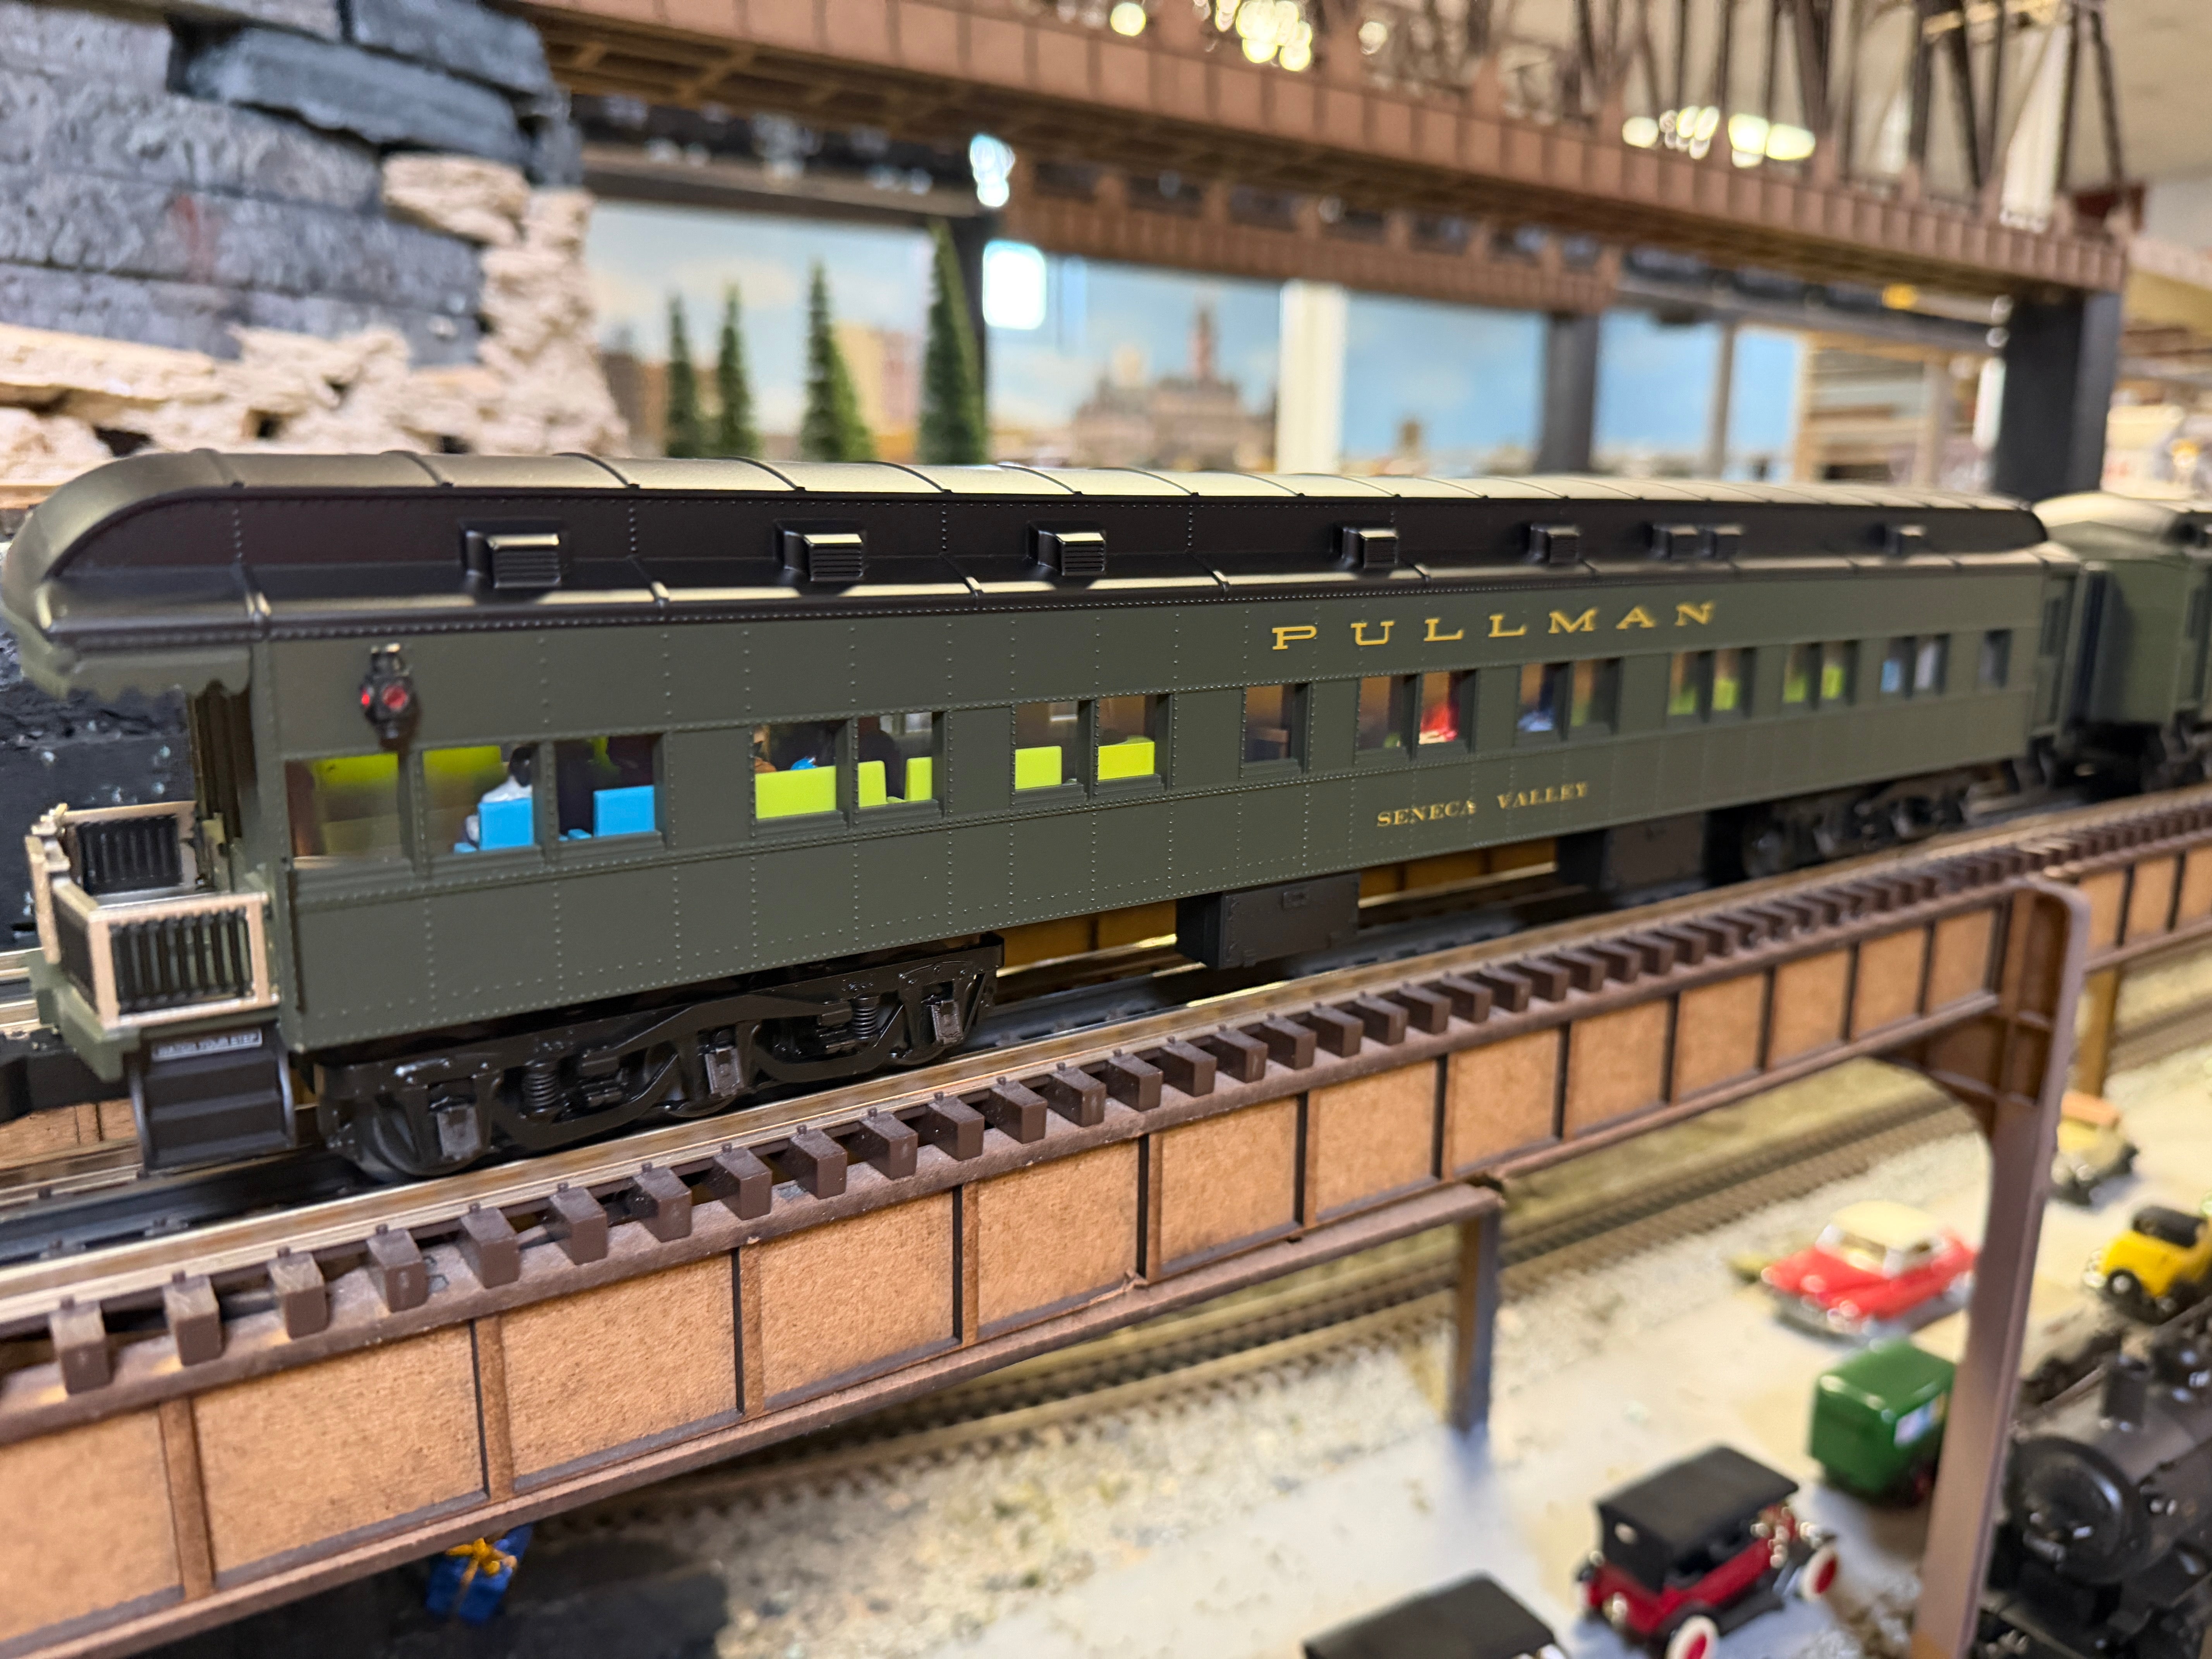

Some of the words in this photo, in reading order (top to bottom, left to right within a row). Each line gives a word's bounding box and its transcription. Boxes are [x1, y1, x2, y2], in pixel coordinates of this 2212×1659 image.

[1271, 601, 1714, 650] PULLMAN
[1377, 800, 1476, 827] SENECA
[1497, 782, 1587, 809] VALLEY
